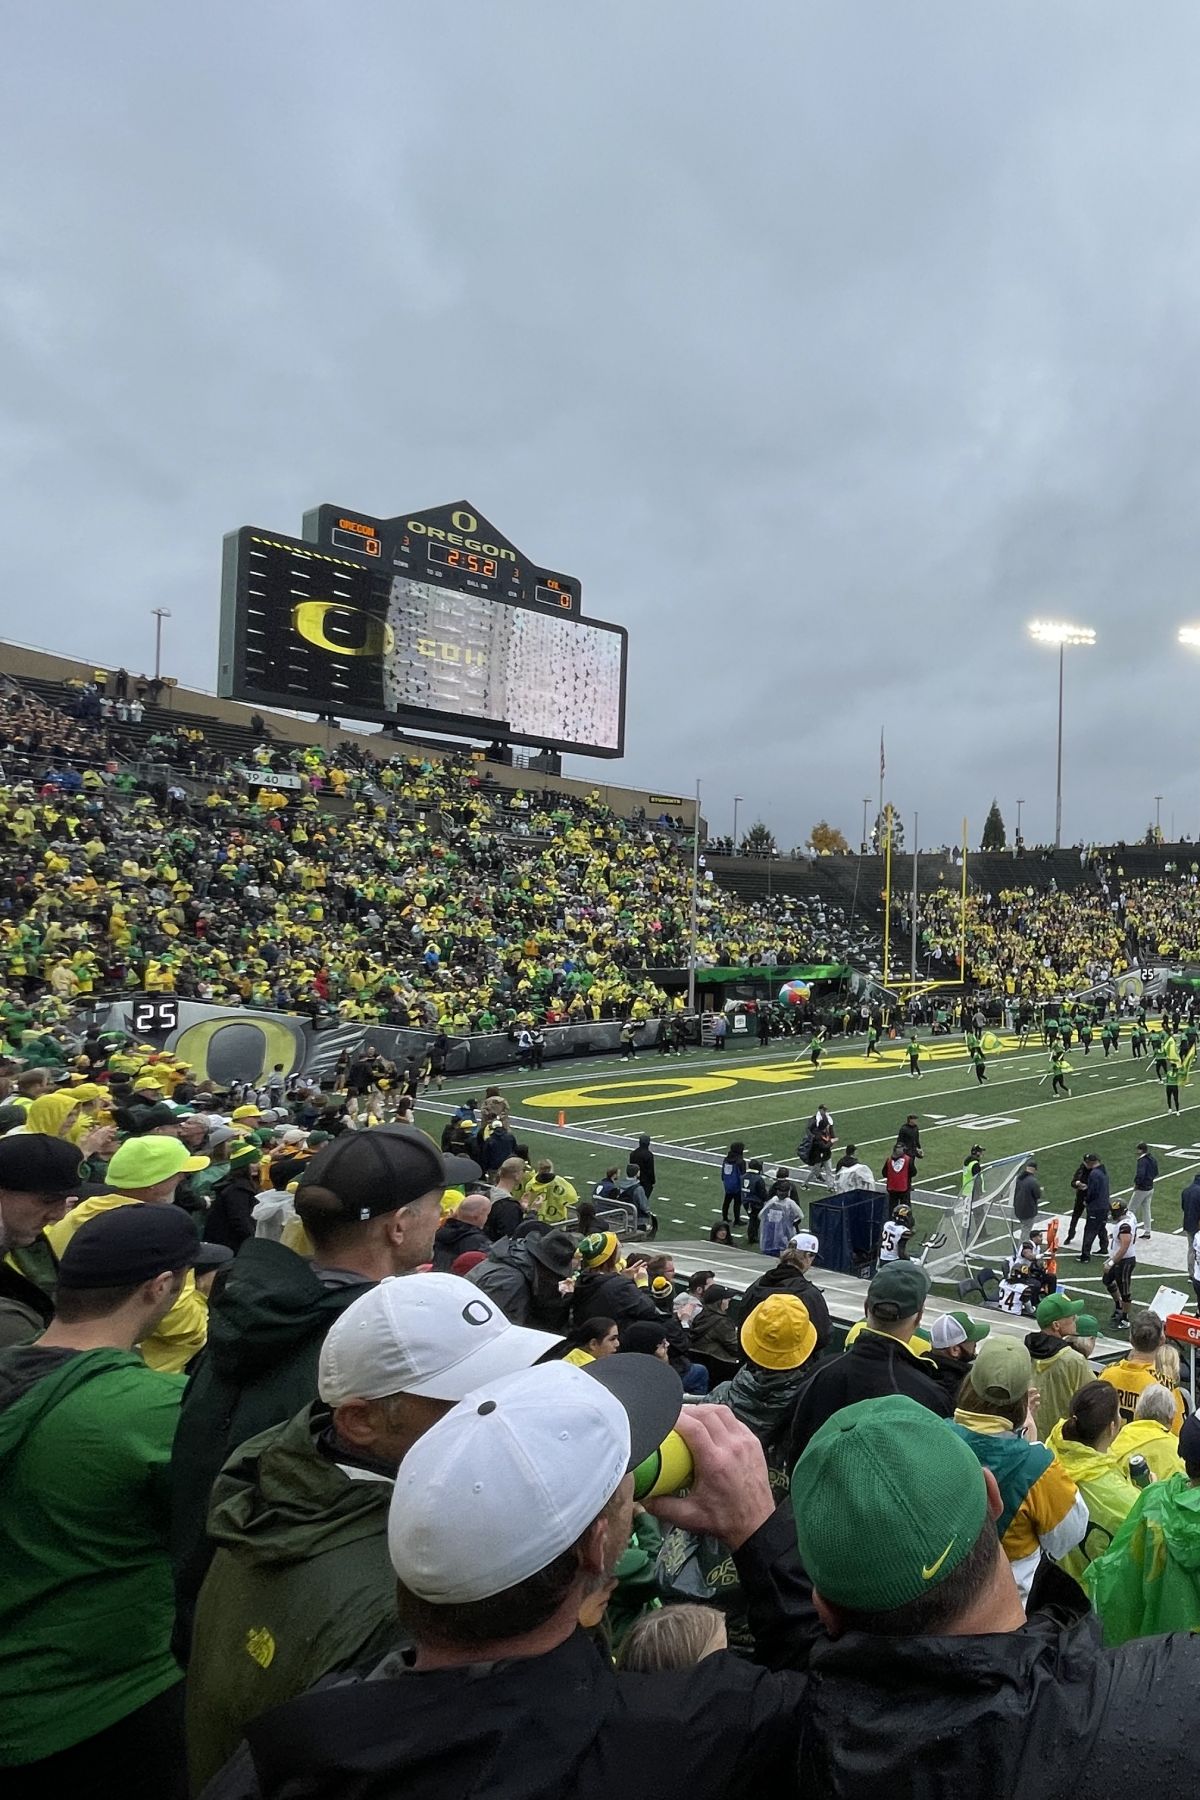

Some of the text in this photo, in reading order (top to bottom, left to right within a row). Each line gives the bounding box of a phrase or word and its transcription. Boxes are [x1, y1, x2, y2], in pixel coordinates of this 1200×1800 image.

[339, 518, 375, 537] OREGON
[366, 540, 377, 554] 0
[407, 521, 516, 562] OREGON
[448, 548, 494, 576] 2:52
[560, 594, 570, 606] 0
[136, 1004, 176, 1030] 25
